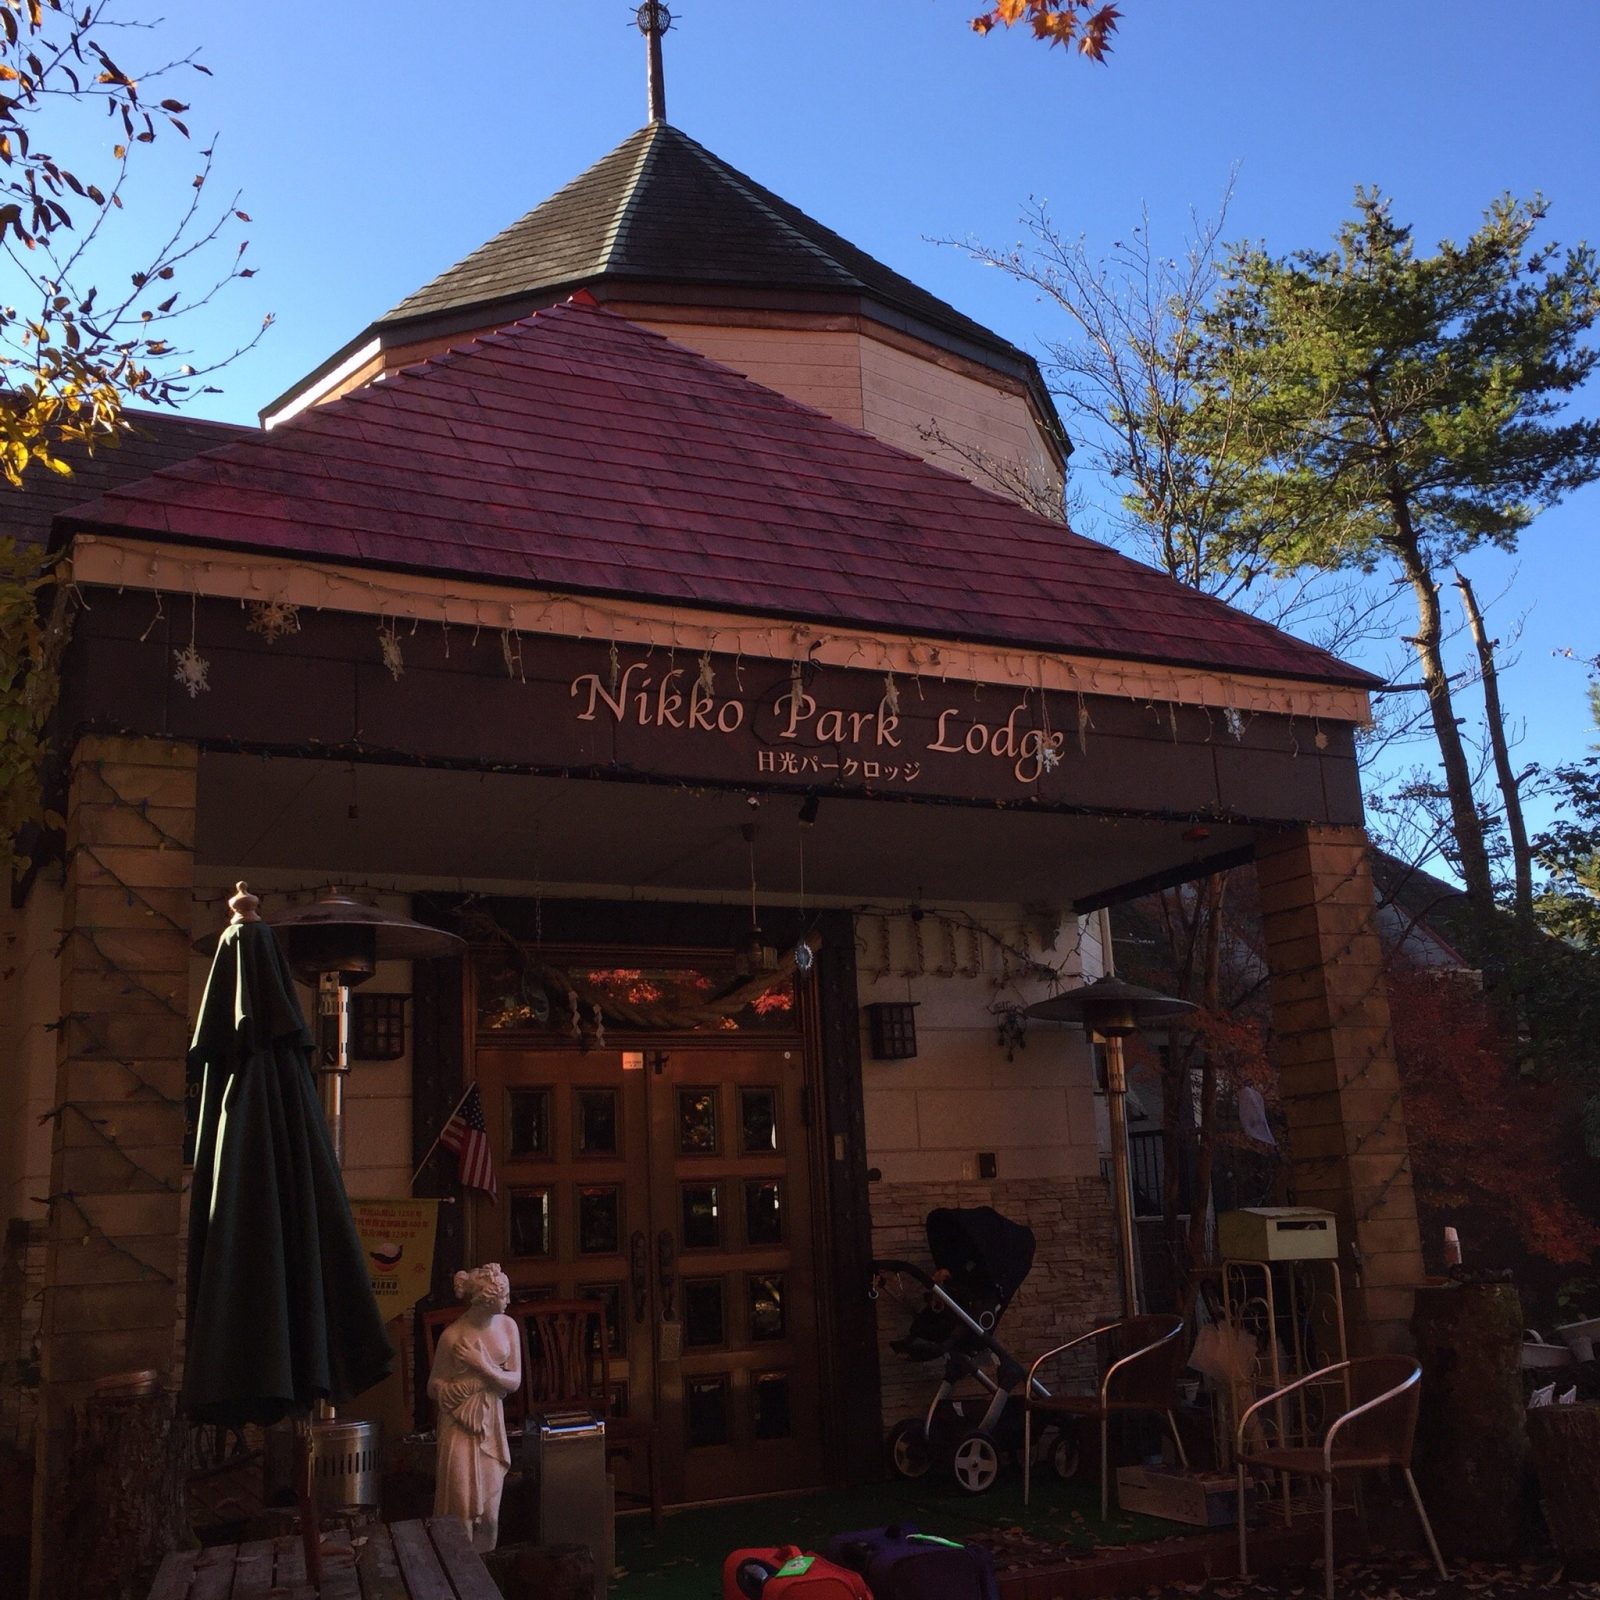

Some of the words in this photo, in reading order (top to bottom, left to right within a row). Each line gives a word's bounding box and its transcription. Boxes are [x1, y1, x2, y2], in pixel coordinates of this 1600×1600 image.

[571, 663, 744, 733] Nikko
[774, 693, 901, 747] Park
[926, 704, 1065, 783] Lodge
[757, 750, 921, 783] 日光パークロッジ
